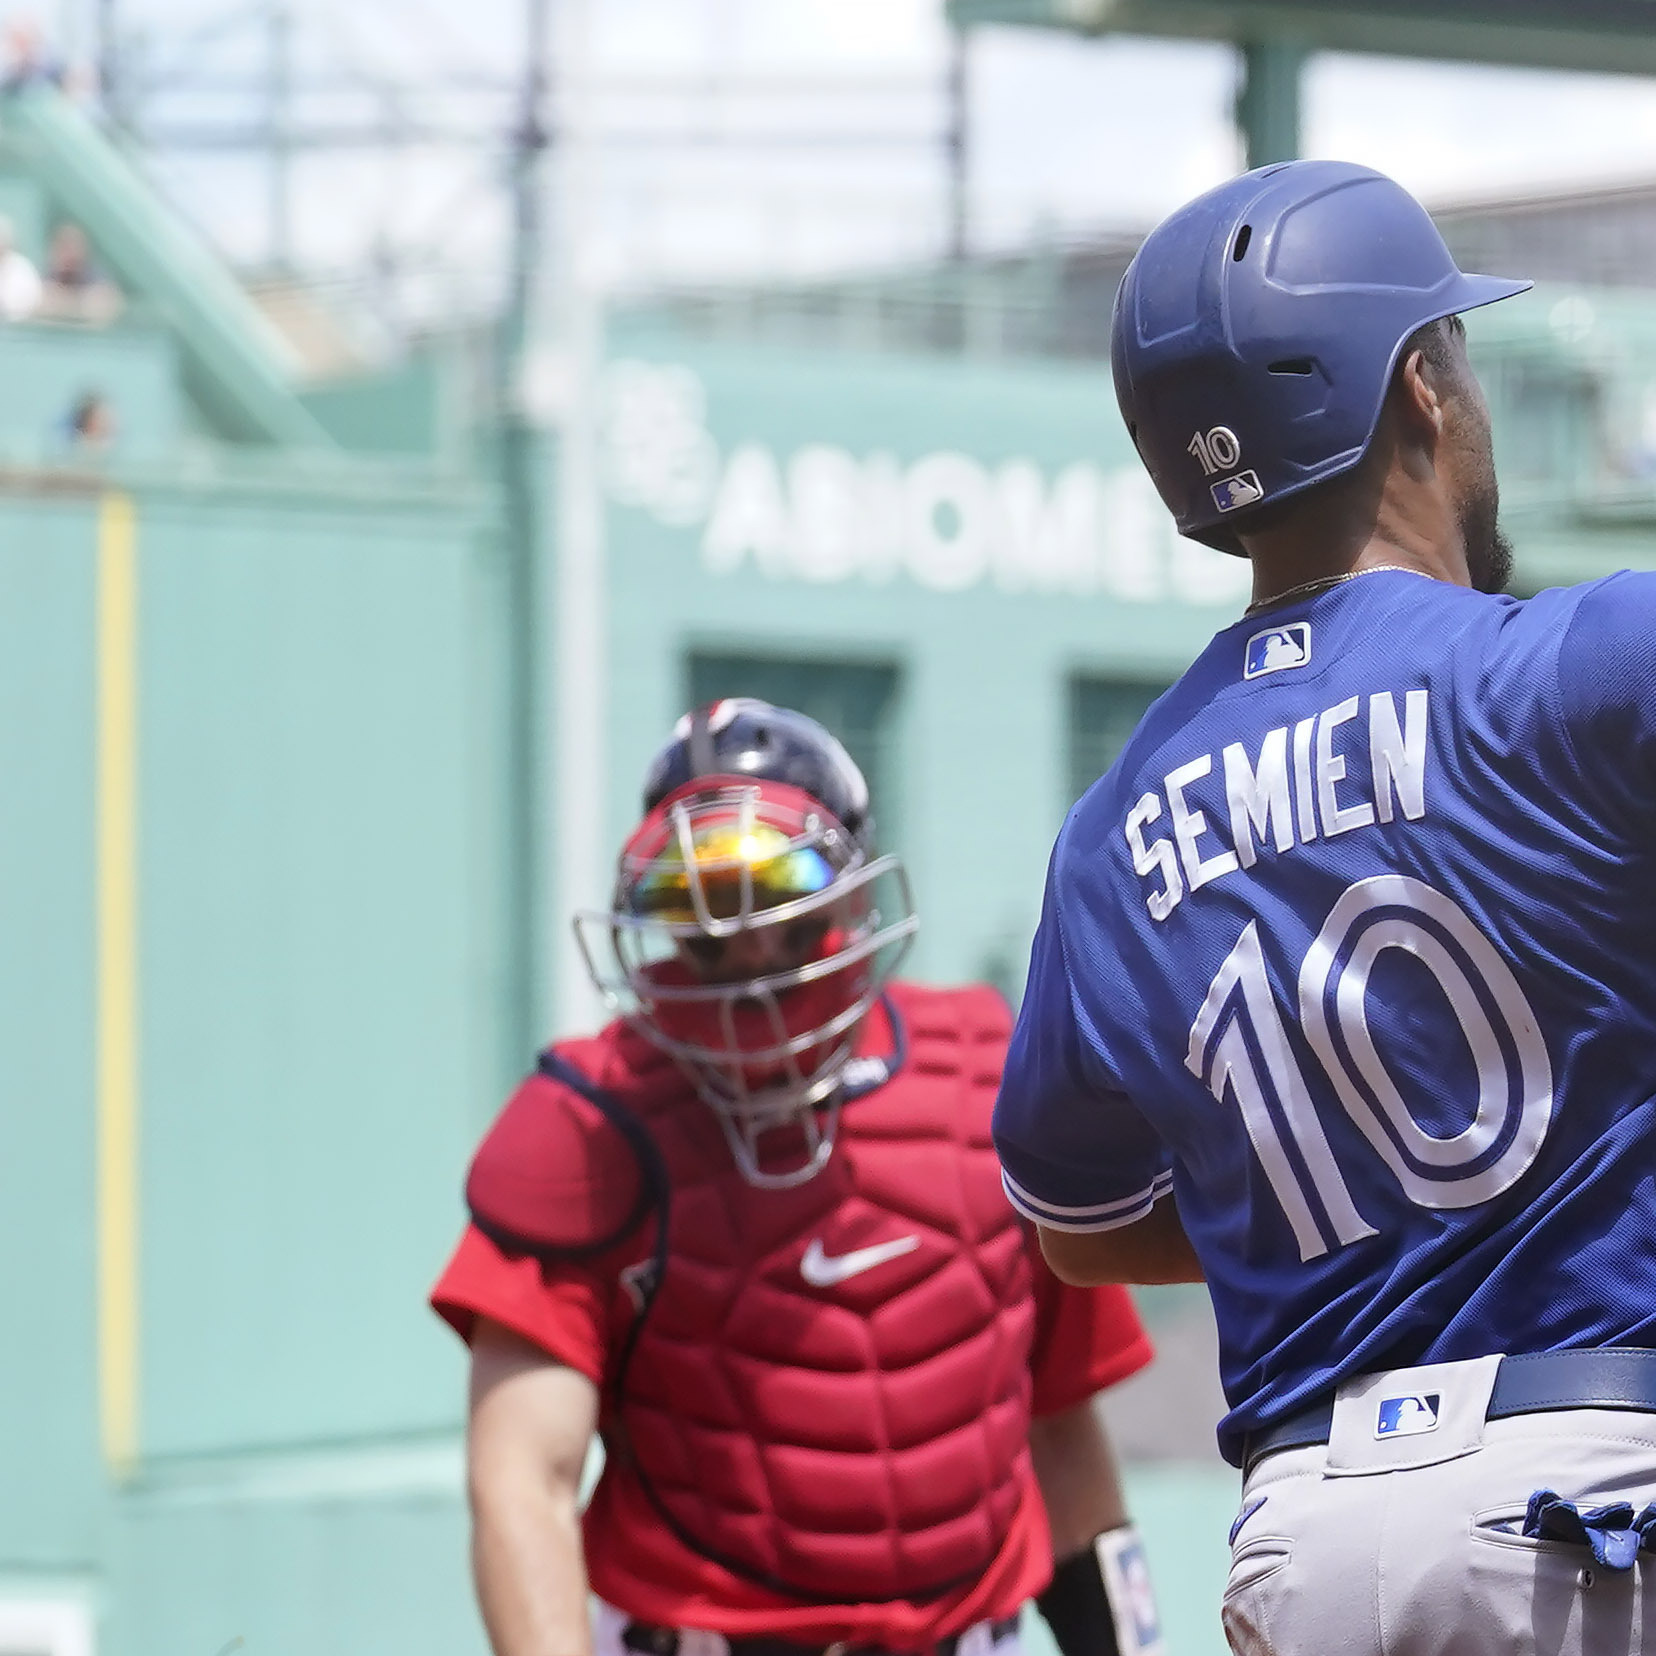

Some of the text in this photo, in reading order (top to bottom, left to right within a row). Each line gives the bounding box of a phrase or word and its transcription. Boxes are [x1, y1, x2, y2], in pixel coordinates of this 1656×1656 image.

[1187, 426, 1240, 475] 10
[1125, 690, 1428, 921] SEMIEN
[1184, 874, 1554, 1263] 10
